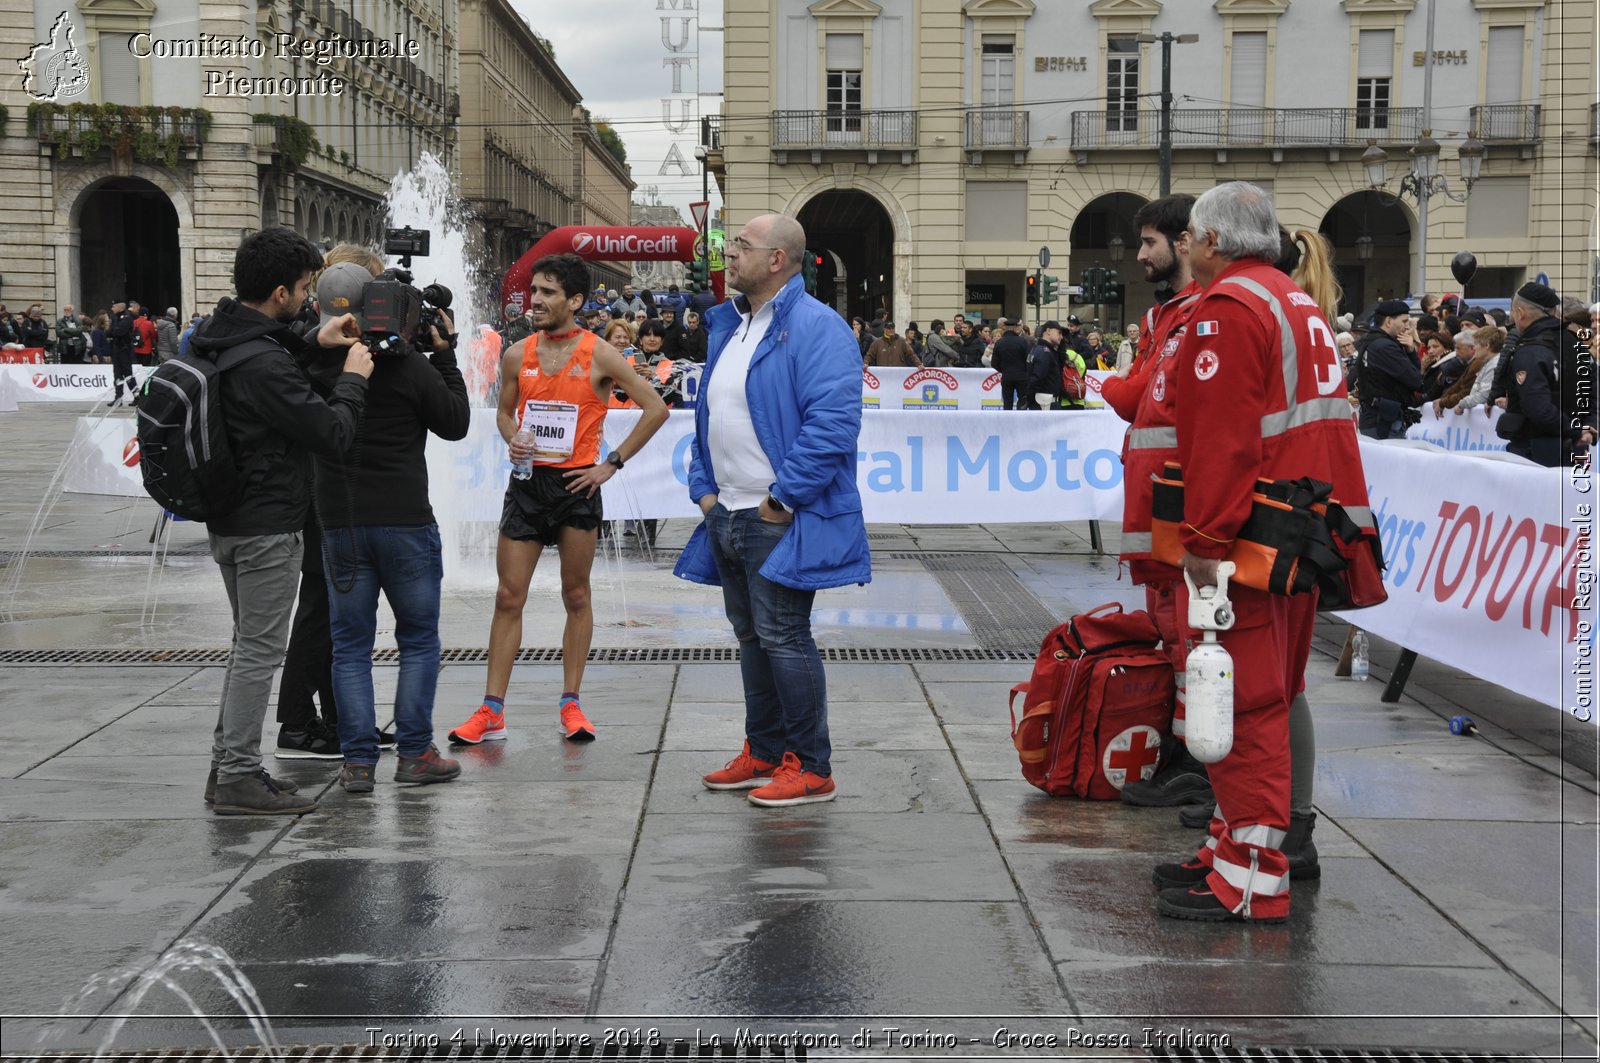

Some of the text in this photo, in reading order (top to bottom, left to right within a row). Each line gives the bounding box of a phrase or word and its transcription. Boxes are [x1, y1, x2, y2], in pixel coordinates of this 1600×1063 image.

[1050, 57, 1087, 65] REALE
[656, 0, 694, 176] UTUA
[596, 235, 678, 254] UniCredit
[971, 291, 993, 300] Store
[49, 374, 108, 388] UniCredit
[904, 370, 957, 389] TAPPOROSSO
[1416, 501, 1585, 644] TOYOTA
